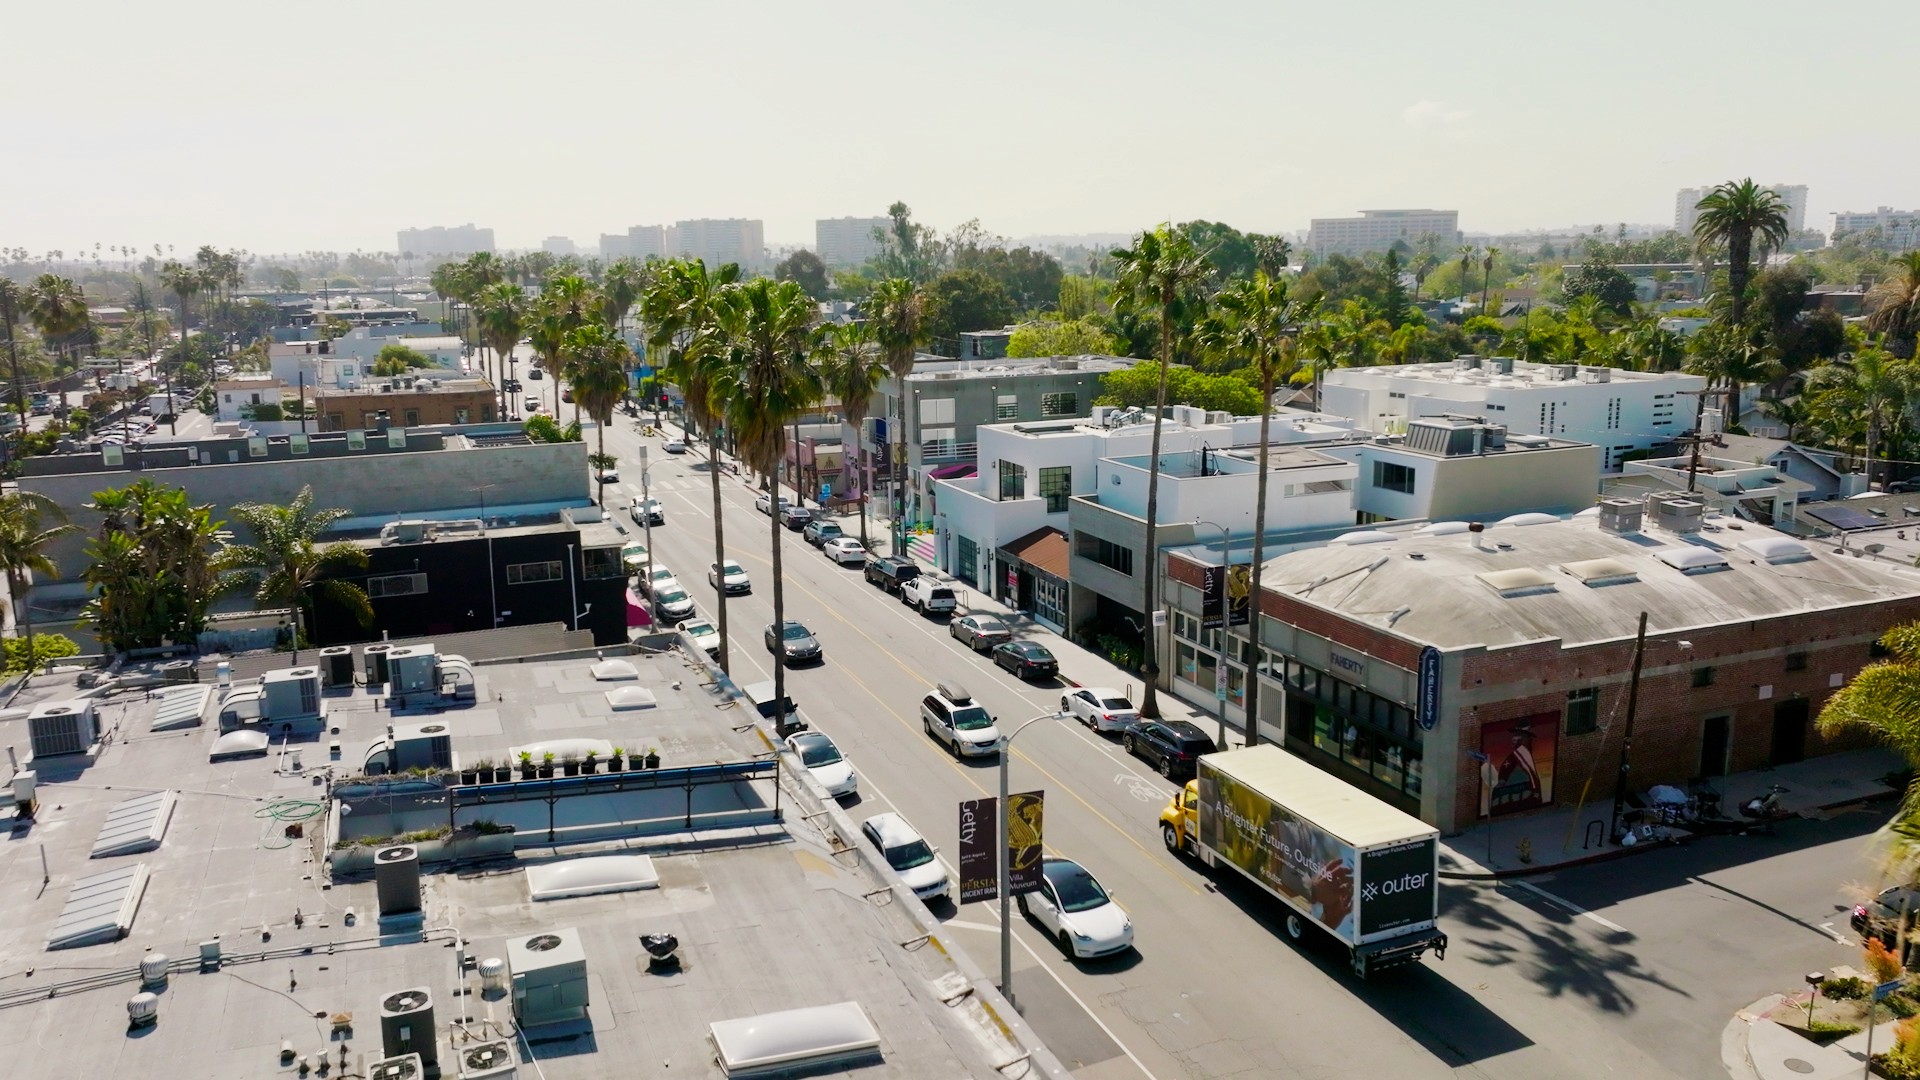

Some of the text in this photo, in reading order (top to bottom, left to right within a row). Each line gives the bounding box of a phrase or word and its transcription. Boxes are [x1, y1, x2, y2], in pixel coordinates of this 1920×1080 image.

[1205, 566, 1216, 594] Getty
[1330, 652, 1364, 674] FAHERTY
[1426, 659, 1435, 720] FAHERTY
[960, 800, 979, 844] Getty
[1216, 801, 1222, 814] A
[1223, 804, 1258, 835] Brighter
[1260, 826, 1293, 858] Future,
[1294, 848, 1333, 882] Outside
[1372, 849, 1390, 858] Brighter
[961, 879, 995, 890] PERSIA
[1009, 873, 1024, 881] Villa
[1010, 880, 1037, 890] Museum
[1382, 872, 1429, 895] outer
[961, 886, 996, 898] ANCIENT IRAN
